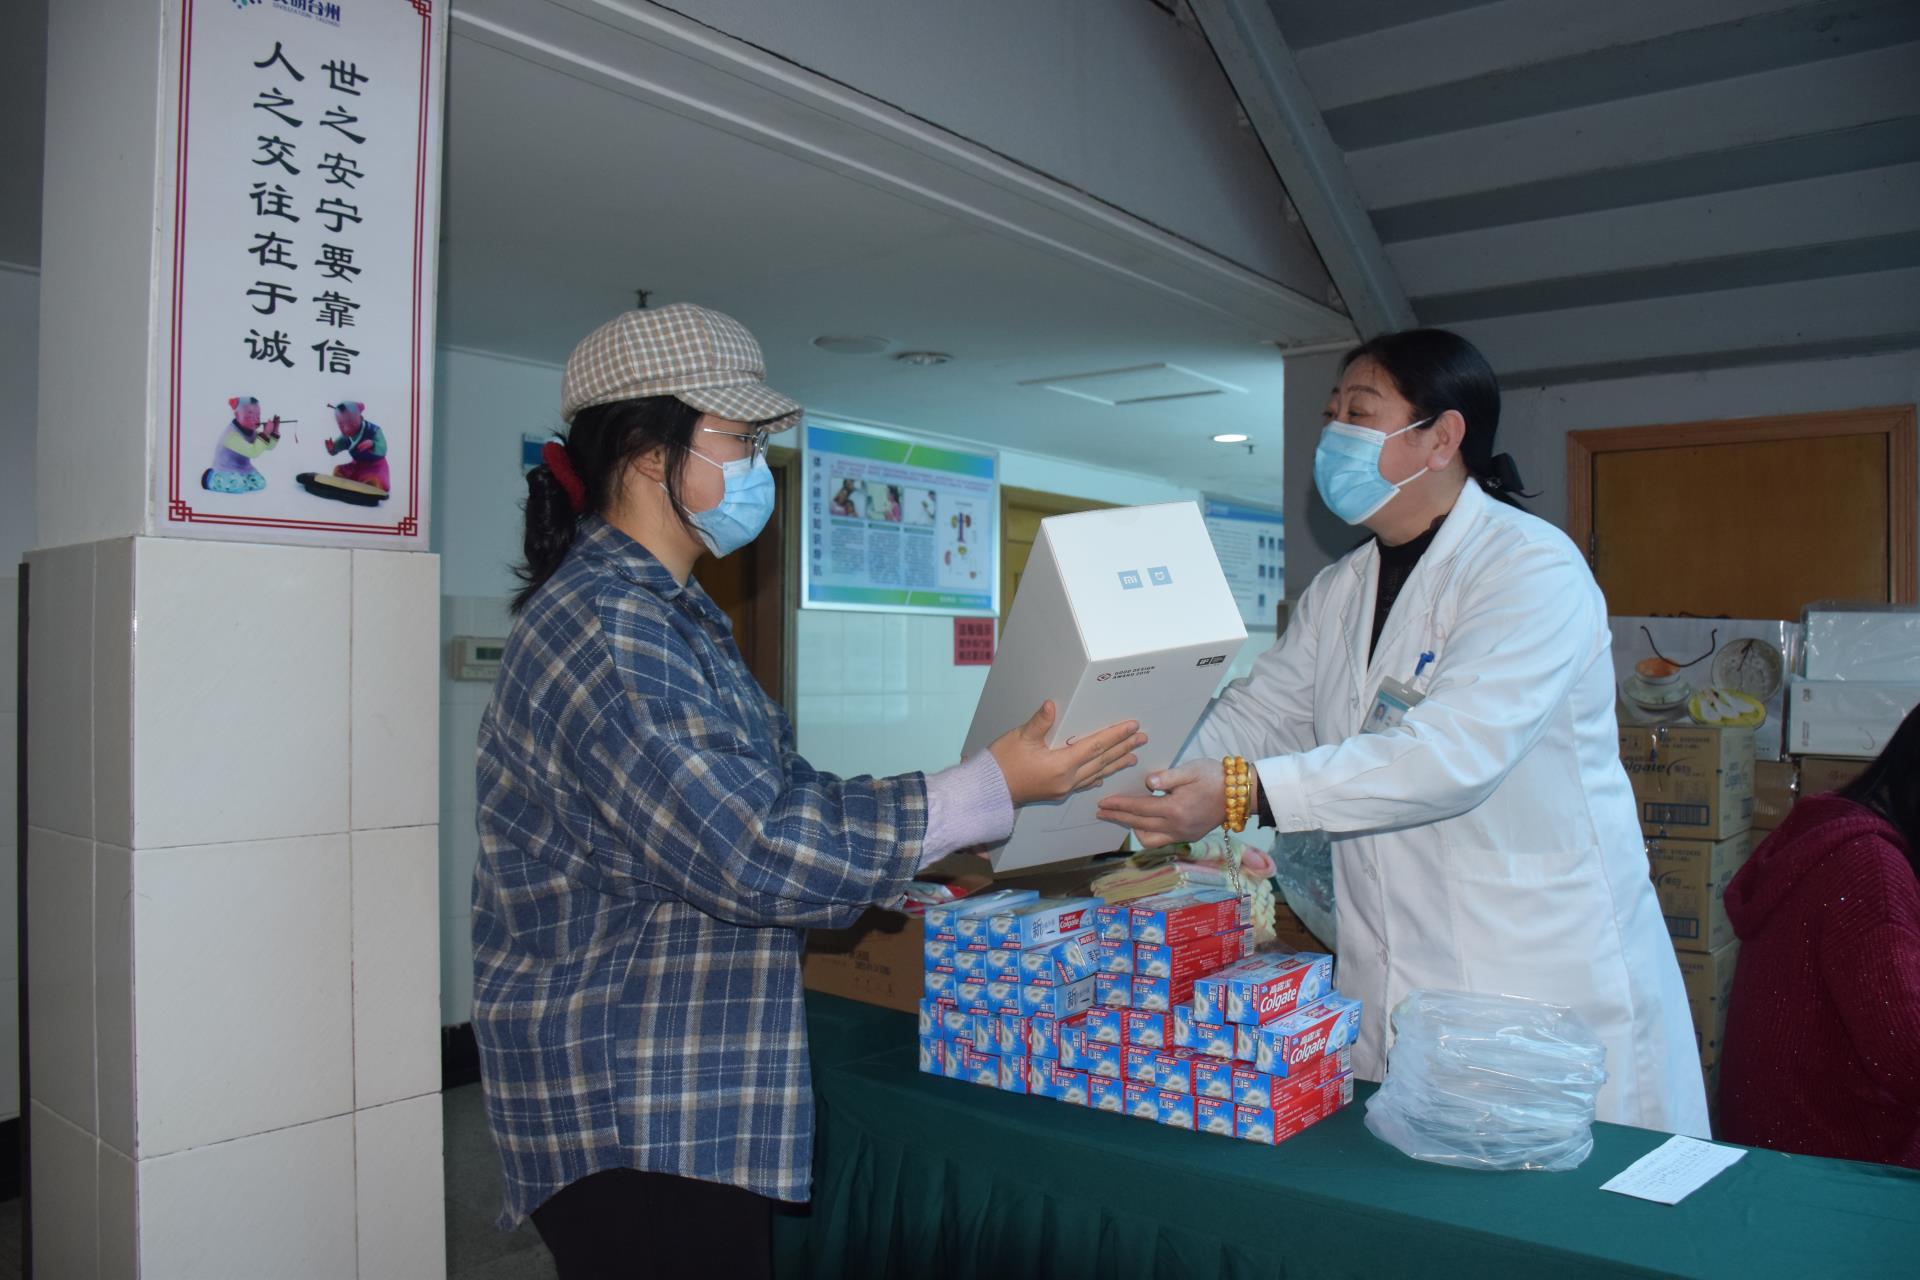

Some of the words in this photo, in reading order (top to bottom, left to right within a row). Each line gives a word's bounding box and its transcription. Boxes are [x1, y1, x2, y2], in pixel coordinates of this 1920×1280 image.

[244, 41, 305, 368] 人之交往在于诚
[311, 59, 369, 375] 世之安宁要靠信
[1260, 988, 1297, 1013] Colgate
[1290, 1037, 1326, 1065] Colgate
